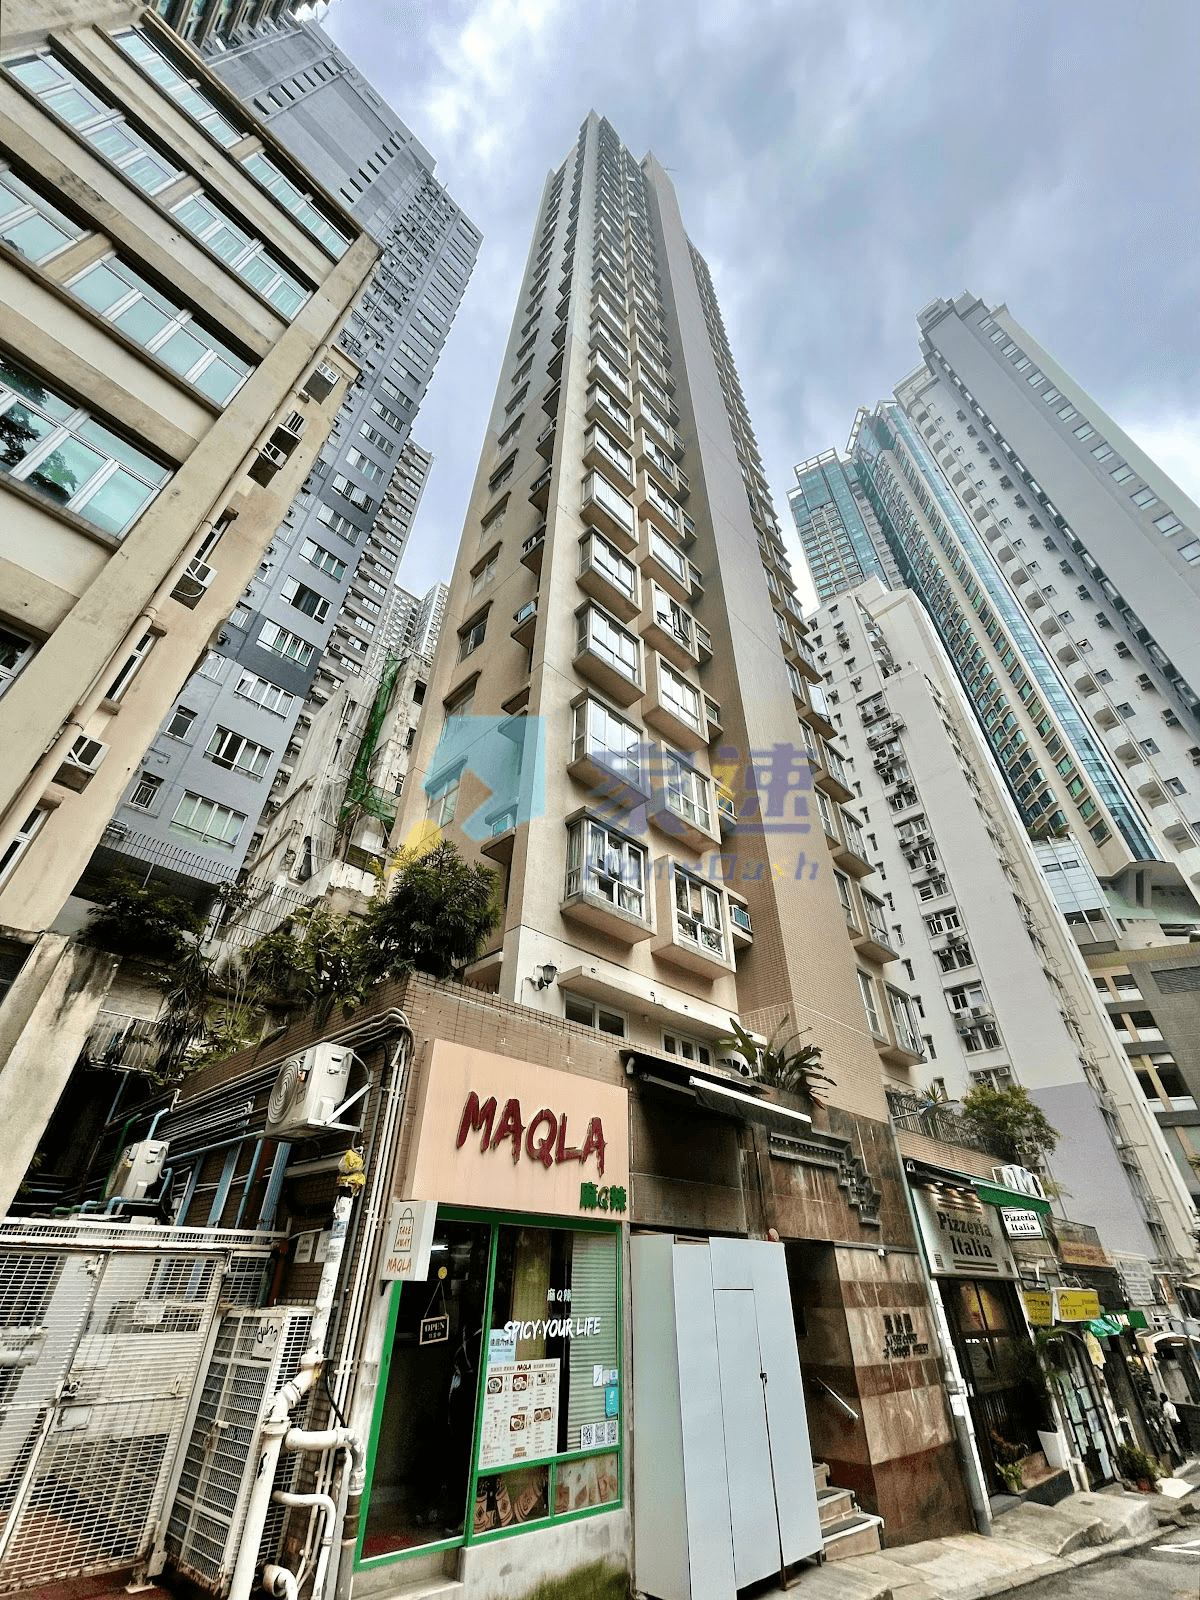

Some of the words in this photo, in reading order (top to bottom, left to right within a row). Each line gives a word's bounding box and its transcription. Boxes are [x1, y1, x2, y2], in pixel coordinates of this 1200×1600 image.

[456, 1091, 607, 1177] MAQLA
[936, 1210, 992, 1237] Pizzeria
[1004, 1213, 1036, 1222] Pizzeria
[399, 1226, 411, 1235] TAKE
[396, 1239, 411, 1247] AWAY
[950, 1235, 992, 1258] Italia
[386, 1258, 411, 1273] MAQLA
[424, 1321, 445, 1333] OPEN
[576, 1316, 601, 1337] LIFE
